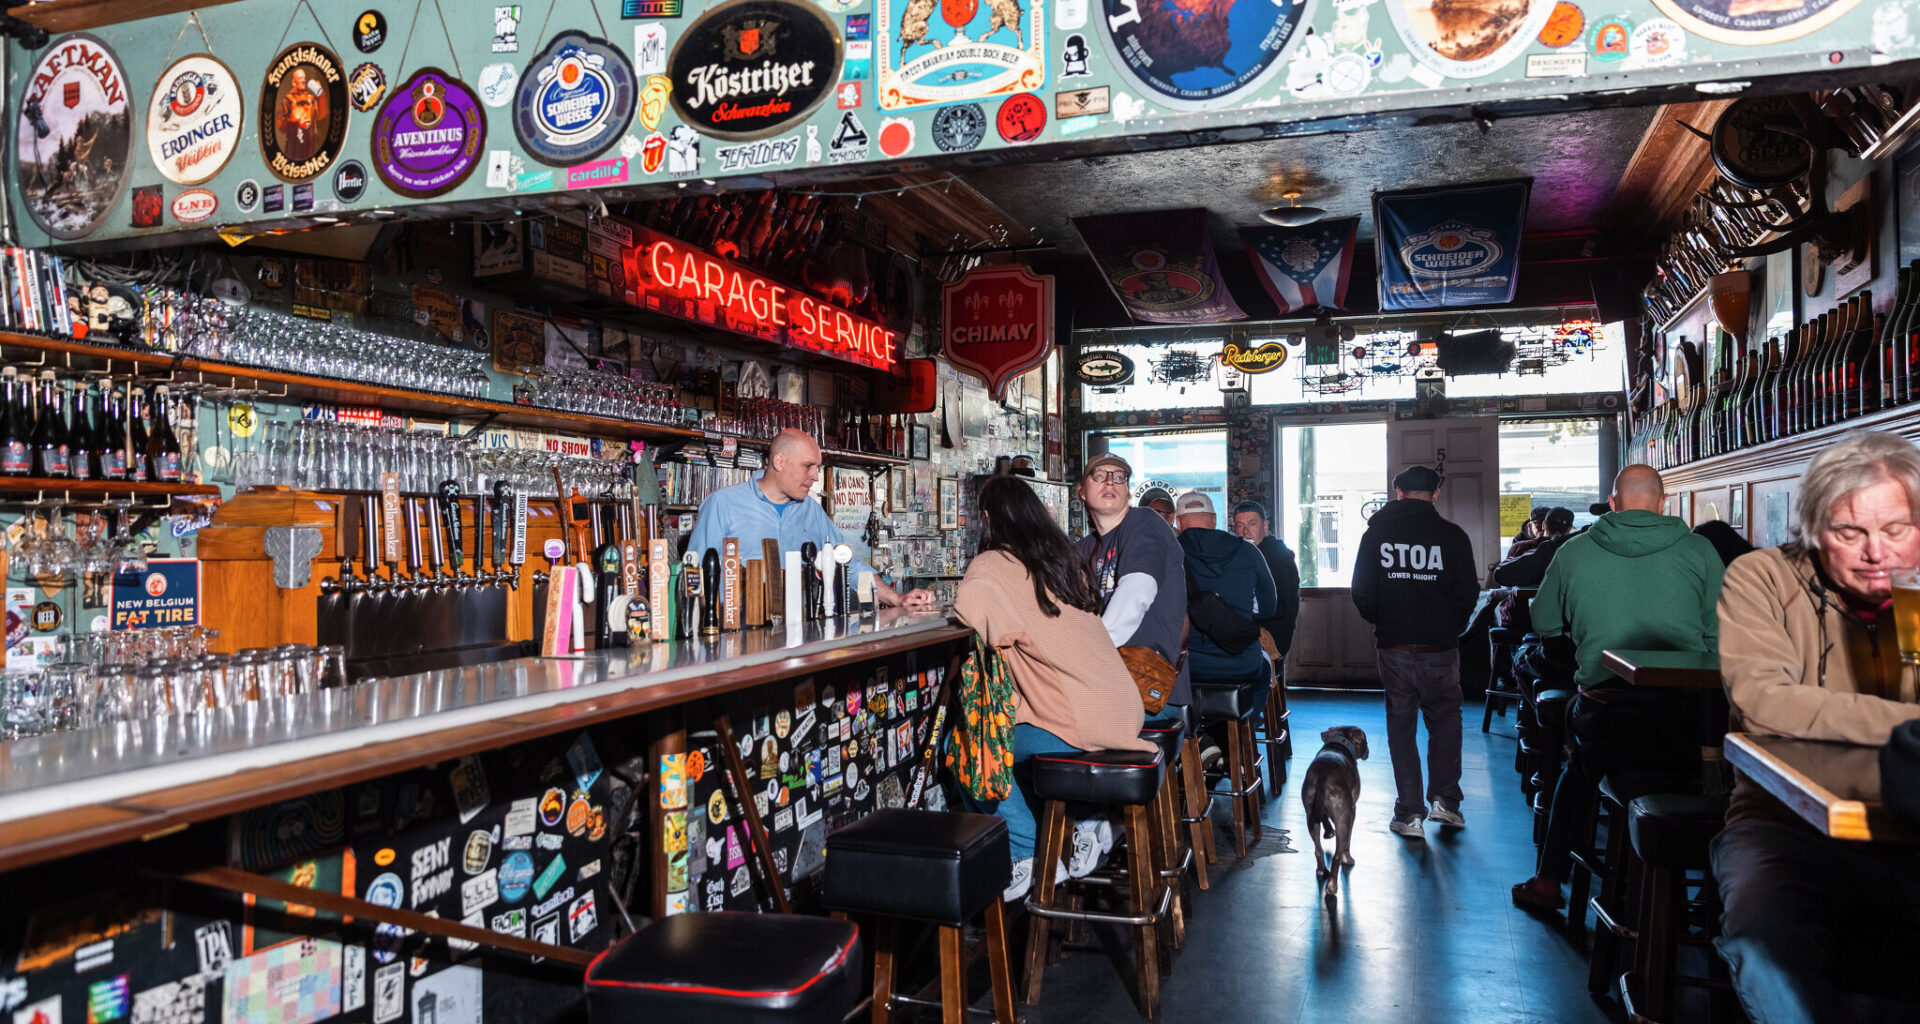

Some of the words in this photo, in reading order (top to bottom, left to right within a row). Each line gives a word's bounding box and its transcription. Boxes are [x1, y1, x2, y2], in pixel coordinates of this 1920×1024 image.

[1734, 18, 1771, 27] CHAMBLY
[1776, 8, 1808, 24] QUÉBEC
[1259, 24, 1279, 51] STRONG
[268, 46, 340, 88] Franziskaner
[922, 50, 955, 70] BAVARIAN
[957, 48, 982, 60] DOUBLE
[983, 48, 999, 58] BOCK
[1001, 51, 1019, 65] BEER
[1530, 57, 1583, 67] DESCHUTES
[1239, 63, 1263, 82] CANADA
[547, 92, 601, 117] SCHNEIDER
[712, 98, 792, 123] Schwarzbier
[556, 107, 593, 127] WEISSE
[161, 113, 233, 161] ERDINGER
[393, 127, 463, 147] AVENTINUS
[271, 150, 330, 179] Weissbier
[178, 199, 213, 211] LNB
[1414, 250, 1484, 262] SCHNEIDER
[1425, 258, 1473, 268] WEISSE
[651, 240, 786, 326] GARAGE
[800, 297, 897, 364] SERVICE
[951, 322, 1036, 345] CHIMAY
[1223, 344, 1282, 367] Radeberger
[337, 406, 381, 418] MEDICAL
[561, 440, 589, 457] SHOW
[848, 475, 865, 490] CANS
[518, 494, 526, 523] BROOKS
[847, 491, 873, 507] BOTTLES
[384, 493, 399, 558] Cellarmaker
[517, 525, 526, 539] DRY
[516, 540, 525, 562] CIDER
[1380, 542, 1444, 571] STOA
[1413, 573, 1437, 581] HAIGHT
[651, 561, 667, 635] Cellarmaker
[725, 558, 738, 625] Cellarmaker
[117, 600, 143, 609] NEW
[146, 597, 194, 608] BELGIUM
[116, 610, 149, 626] FAT
[154, 607, 194, 624] TIRE
